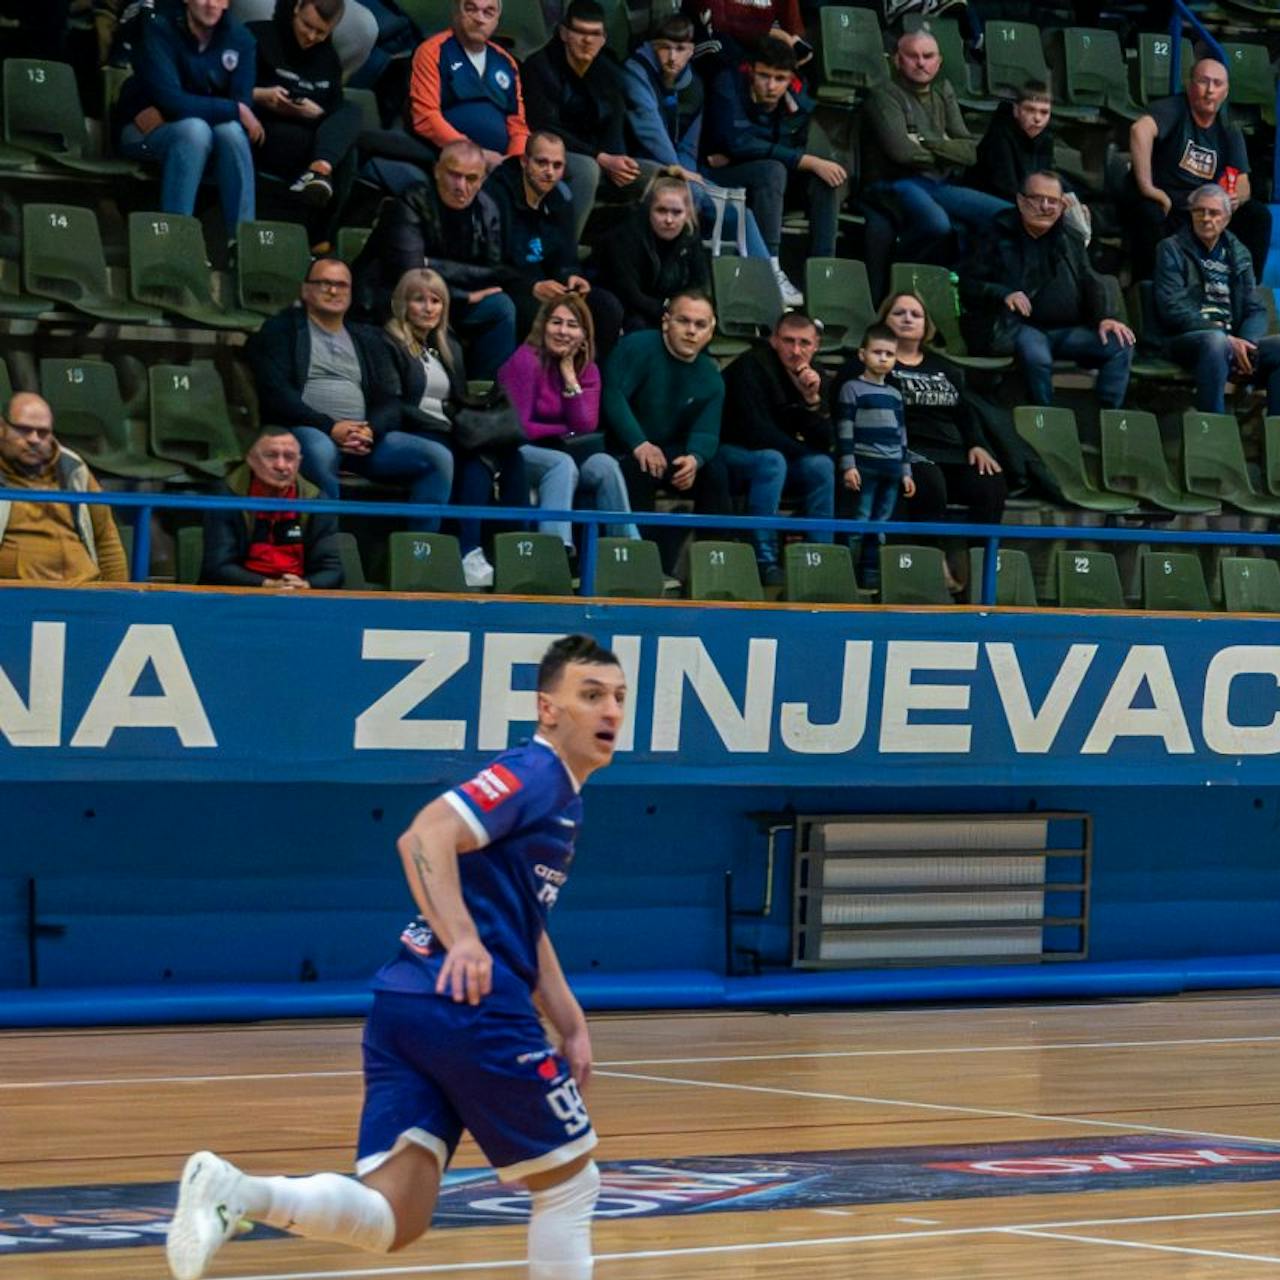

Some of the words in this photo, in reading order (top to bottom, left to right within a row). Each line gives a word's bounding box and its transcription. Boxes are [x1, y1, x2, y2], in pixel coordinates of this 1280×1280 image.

[27, 69, 46, 83] 13
[49, 213, 68, 229] 14
[172, 375, 190, 391] 14
[517, 541, 534, 556] 12
[613, 547, 628, 562] 11
[709, 550, 726, 565] 21
[805, 551, 822, 567] 19
[1074, 556, 1090, 573] 22
